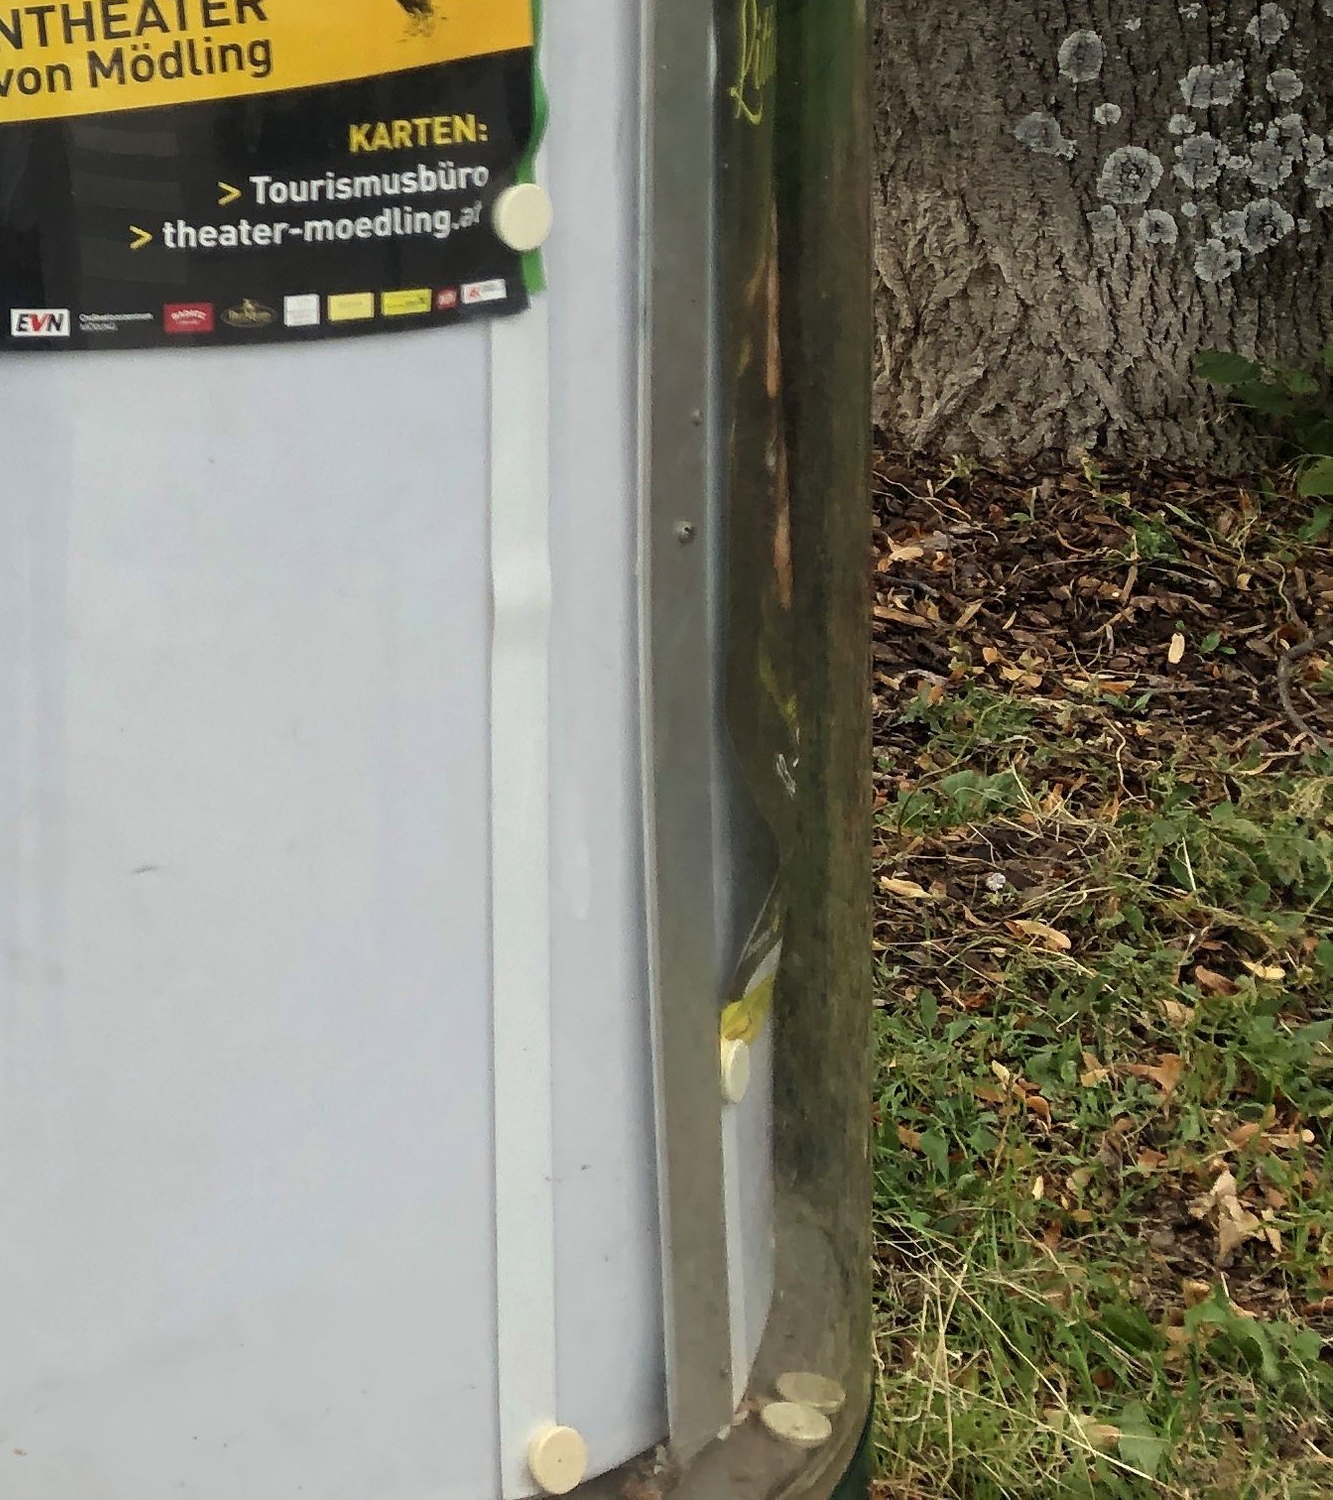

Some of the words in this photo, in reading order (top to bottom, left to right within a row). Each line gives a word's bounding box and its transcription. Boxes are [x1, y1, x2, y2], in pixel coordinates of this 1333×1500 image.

[88, 37, 272, 88] Mödling
[348, 113, 490, 153] KARTEN:
[248, 160, 490, 206] Tourismusbüro
[162, 200, 483, 249] theater-moedling.at
[16, 312, 65, 333] EVN
